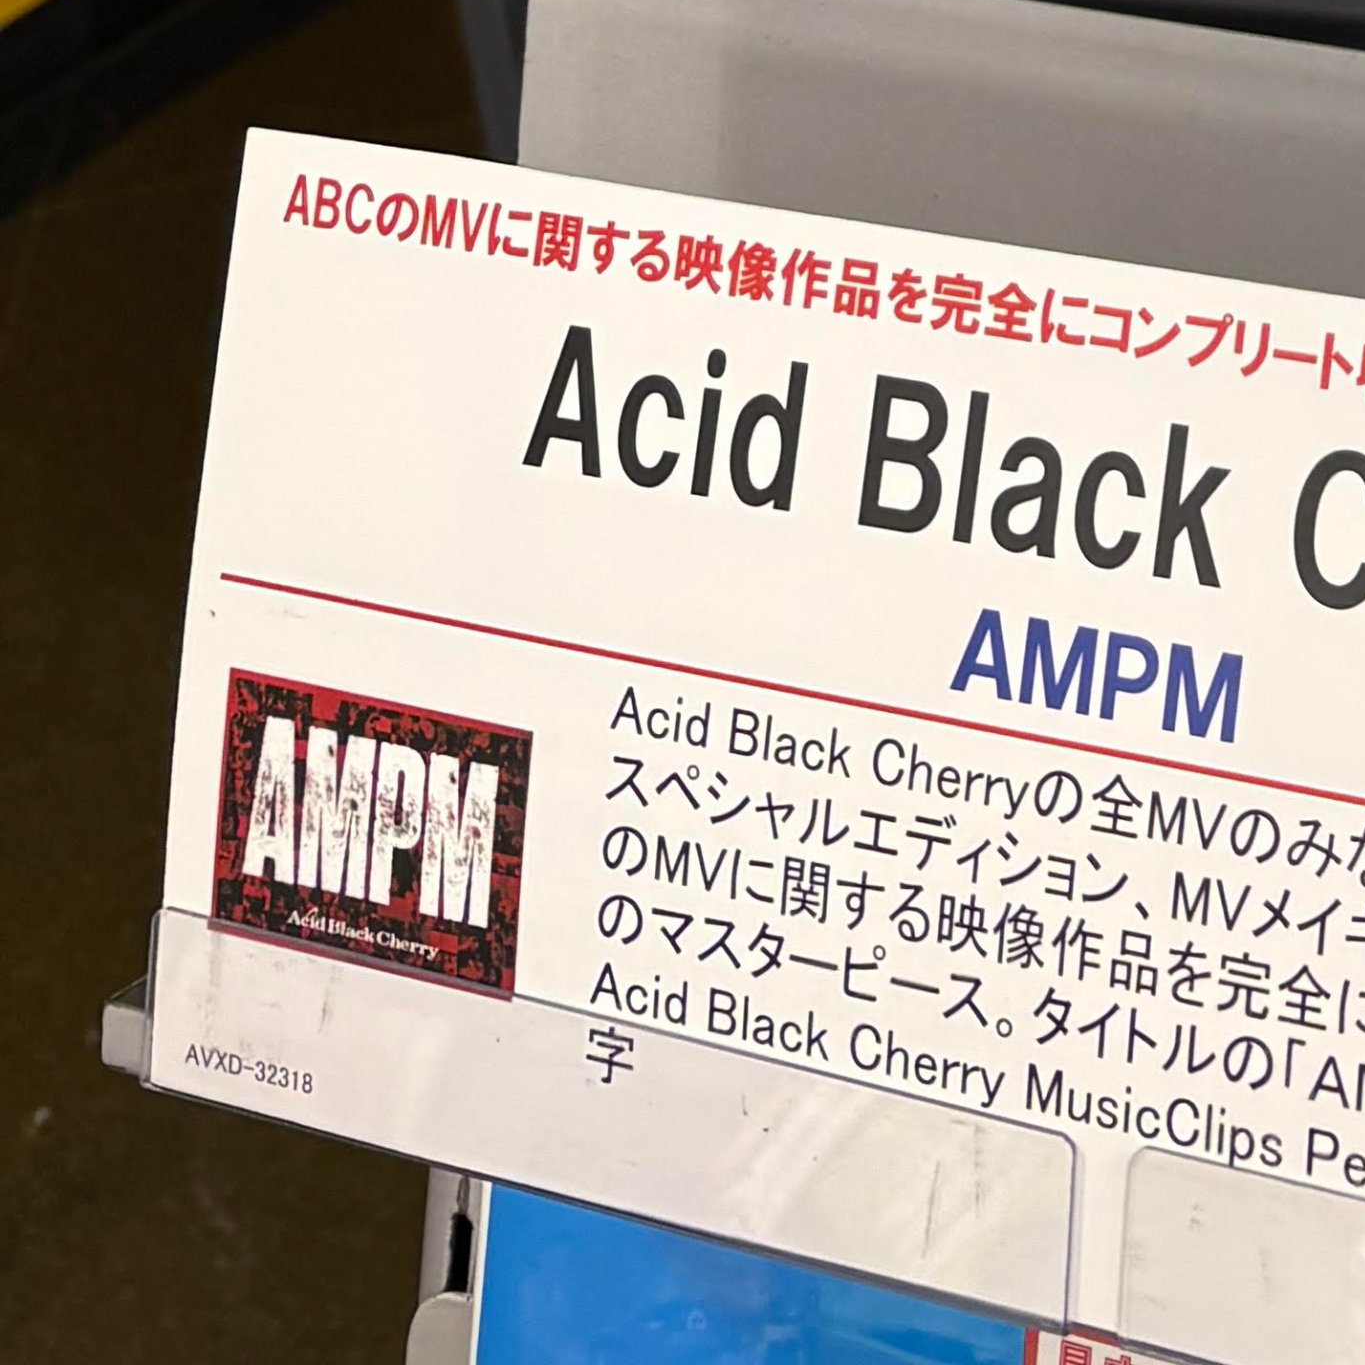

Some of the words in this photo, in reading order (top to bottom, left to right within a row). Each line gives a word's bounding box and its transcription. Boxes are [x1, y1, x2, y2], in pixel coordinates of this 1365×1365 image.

[522, 324, 809, 512] Acid
[857, 373, 1230, 589] Black
[610, 685, 711, 749] Acid
[728, 707, 852, 779] Black
[949, 607, 1243, 744] AMPM
[241, 715, 500, 929] AMPM
[286, 906, 326, 933] Acid
[327, 919, 376, 946] Black
[376, 929, 440, 961] Cherry
[184, 1043, 314, 1095] AVXD-32318
[585, 1025, 636, 1084] 字
[590, 961, 688, 1025] Acid
[706, 989, 830, 1061] Black
[849, 1023, 1006, 1109] Cherry
[1024, 1063, 1284, 1169] MusicClips
